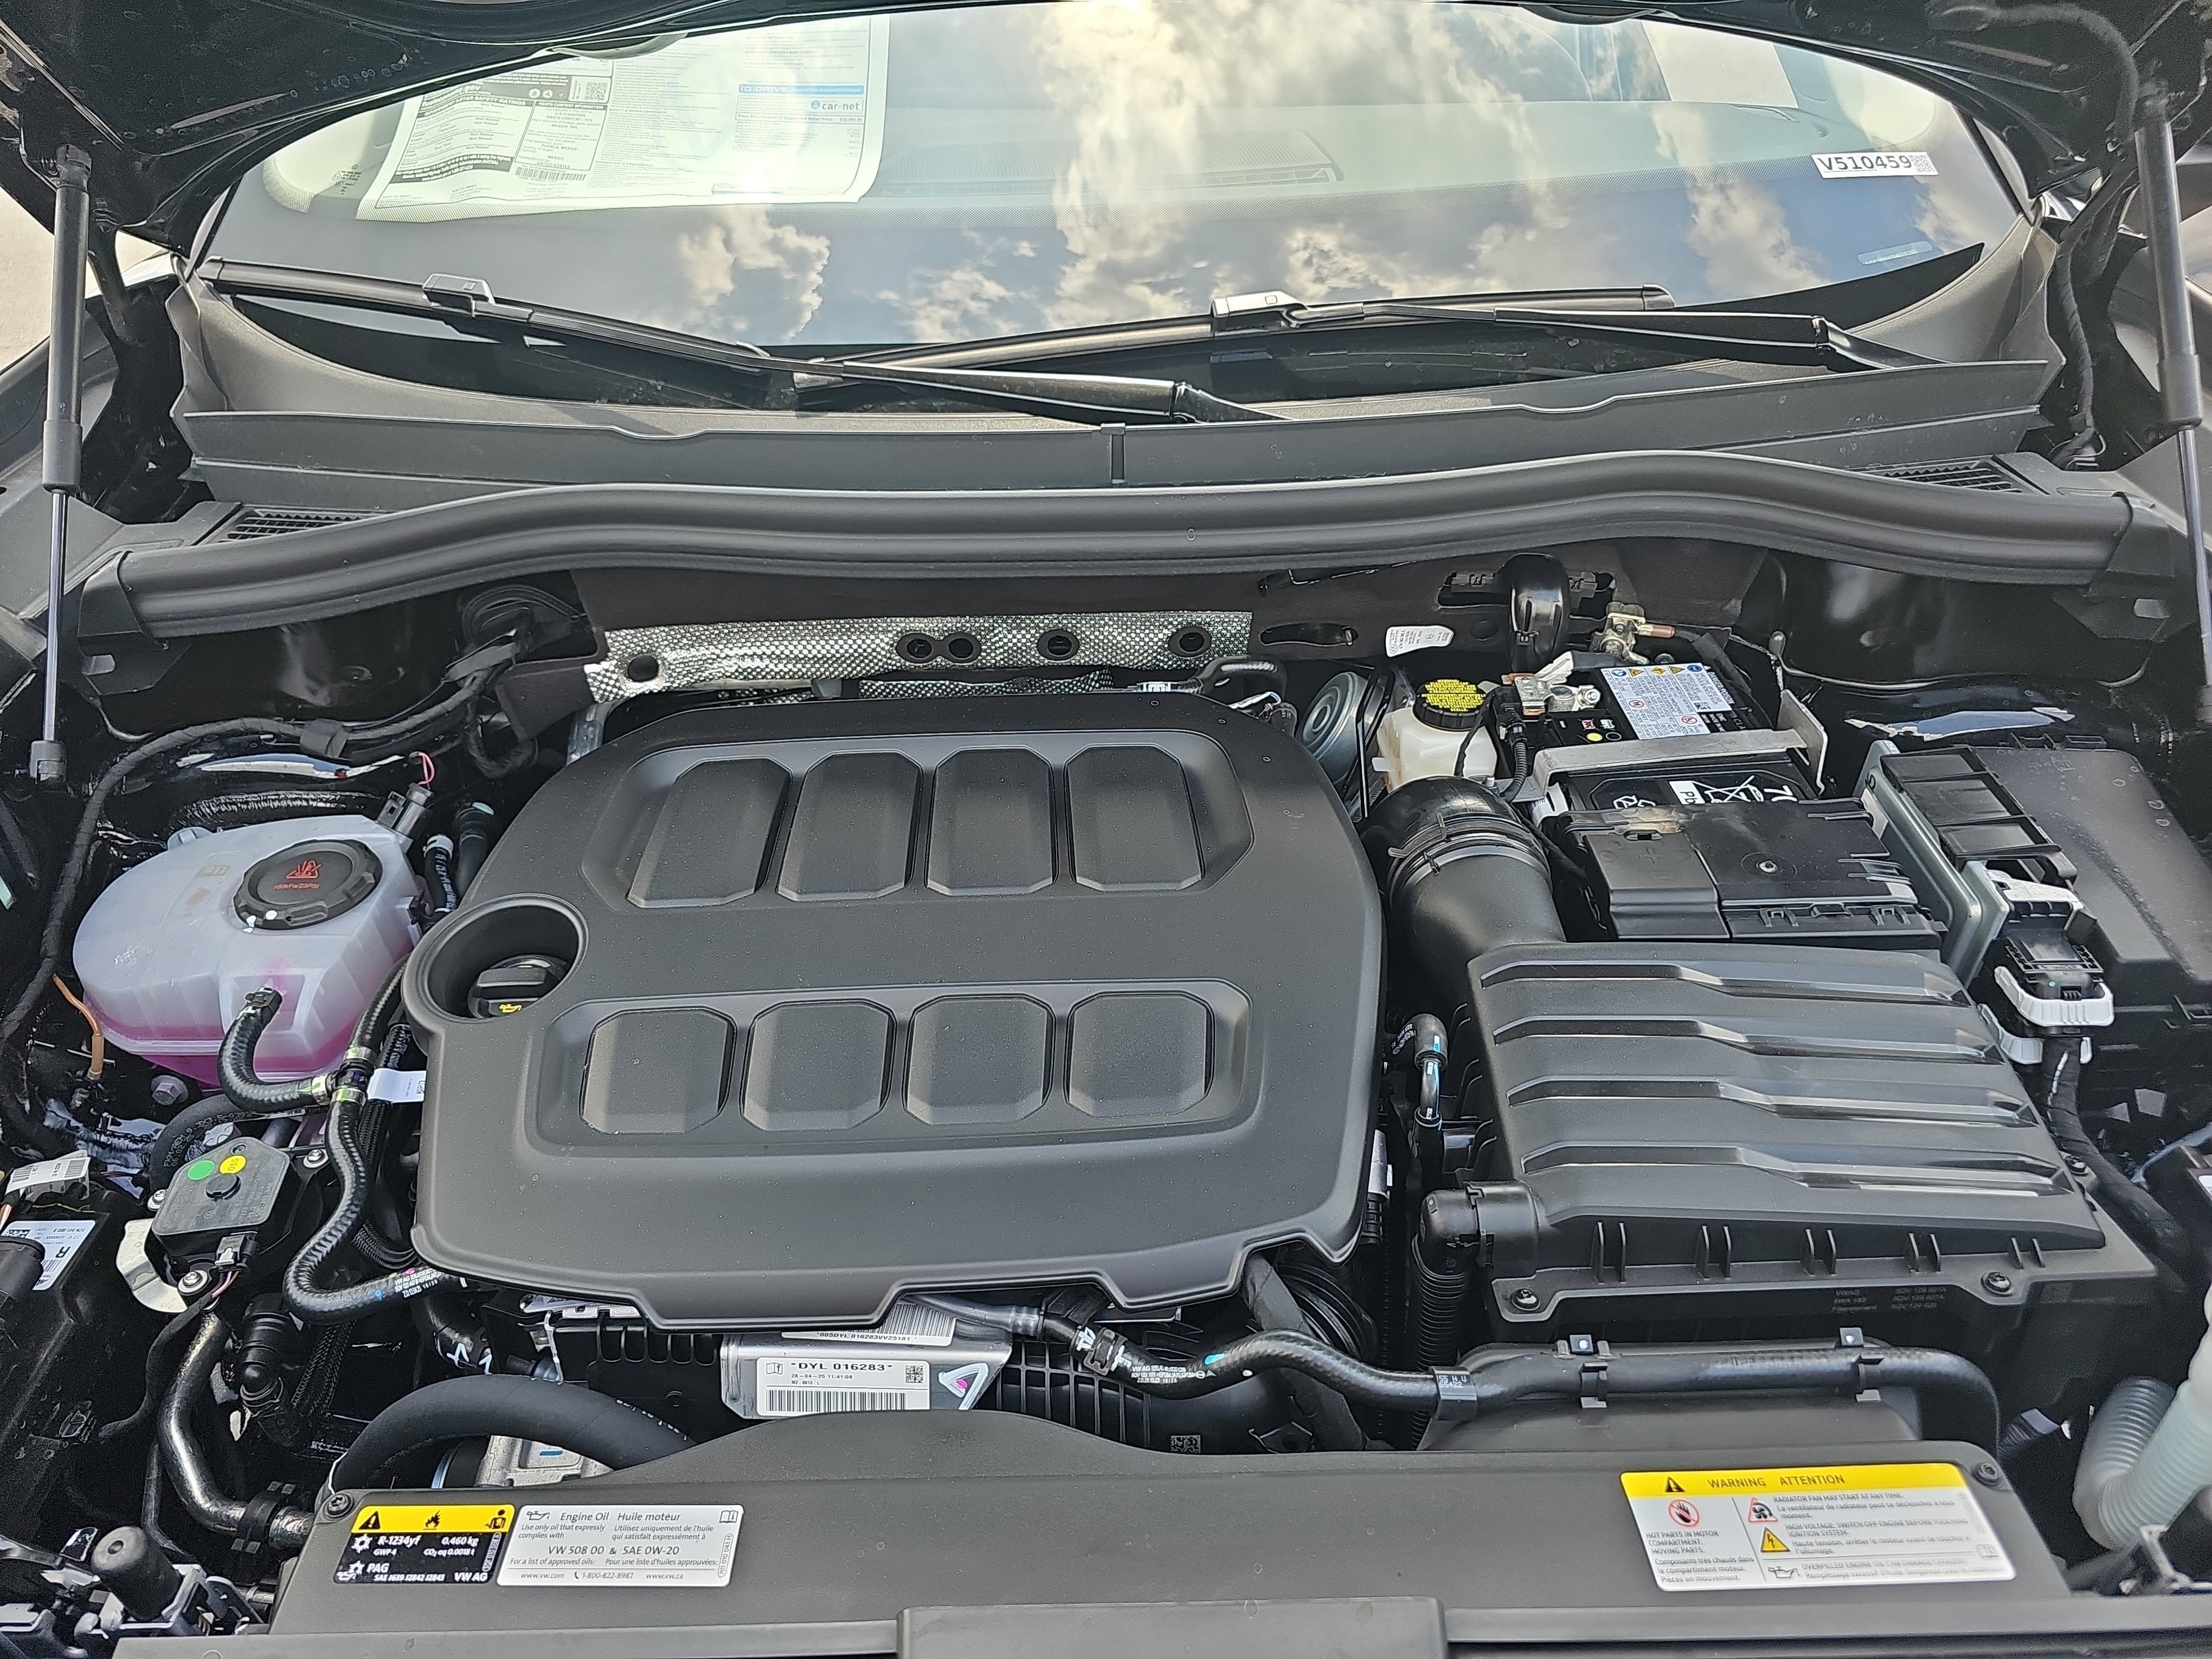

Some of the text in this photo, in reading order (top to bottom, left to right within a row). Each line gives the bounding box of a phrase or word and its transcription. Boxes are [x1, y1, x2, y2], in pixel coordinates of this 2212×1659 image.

[422, 85, 481, 107] fueleconomy.gov
[821, 102, 859, 111] car-net
[1817, 155, 1913, 170] V510459
[1680, 792, 1697, 805] Pb
[55, 1246, 71, 1258] R
[1707, 1474, 1846, 1488] WARNING ATTENTION
[560, 1512, 610, 1523] Engine Oil
[617, 1512, 643, 1521] Huile
[534, 1523, 550, 1532] only
[575, 1524, 606, 1532] expressly
[640, 1525, 682, 1534] uniquement
[518, 1532, 548, 1540] complies
[612, 1533, 623, 1541] qui
[624, 1532, 651, 1540] satisfait
[652, 1532, 699, 1541] expressément
[377, 1535, 479, 1548] R-1234yf 0.460 kg
[1648, 1538, 1703, 1546] COMPARTMENT.
[372, 1548, 391, 1557] GWP
[438, 1549, 448, 1558] eq
[548, 1546, 680, 1555] VW 508 00 & SAE 0W-20
[548, 1558, 581, 1566] approved
[677, 1558, 718, 1567] approuvées:
[1655, 1558, 1697, 1566] Composants
[366, 1562, 390, 1573] PAG
[1666, 1566, 1716, 1575] compartiment
[372, 1573, 388, 1581] SAE
[454, 1572, 472, 1582] VW
[471, 1572, 488, 1582] AG
